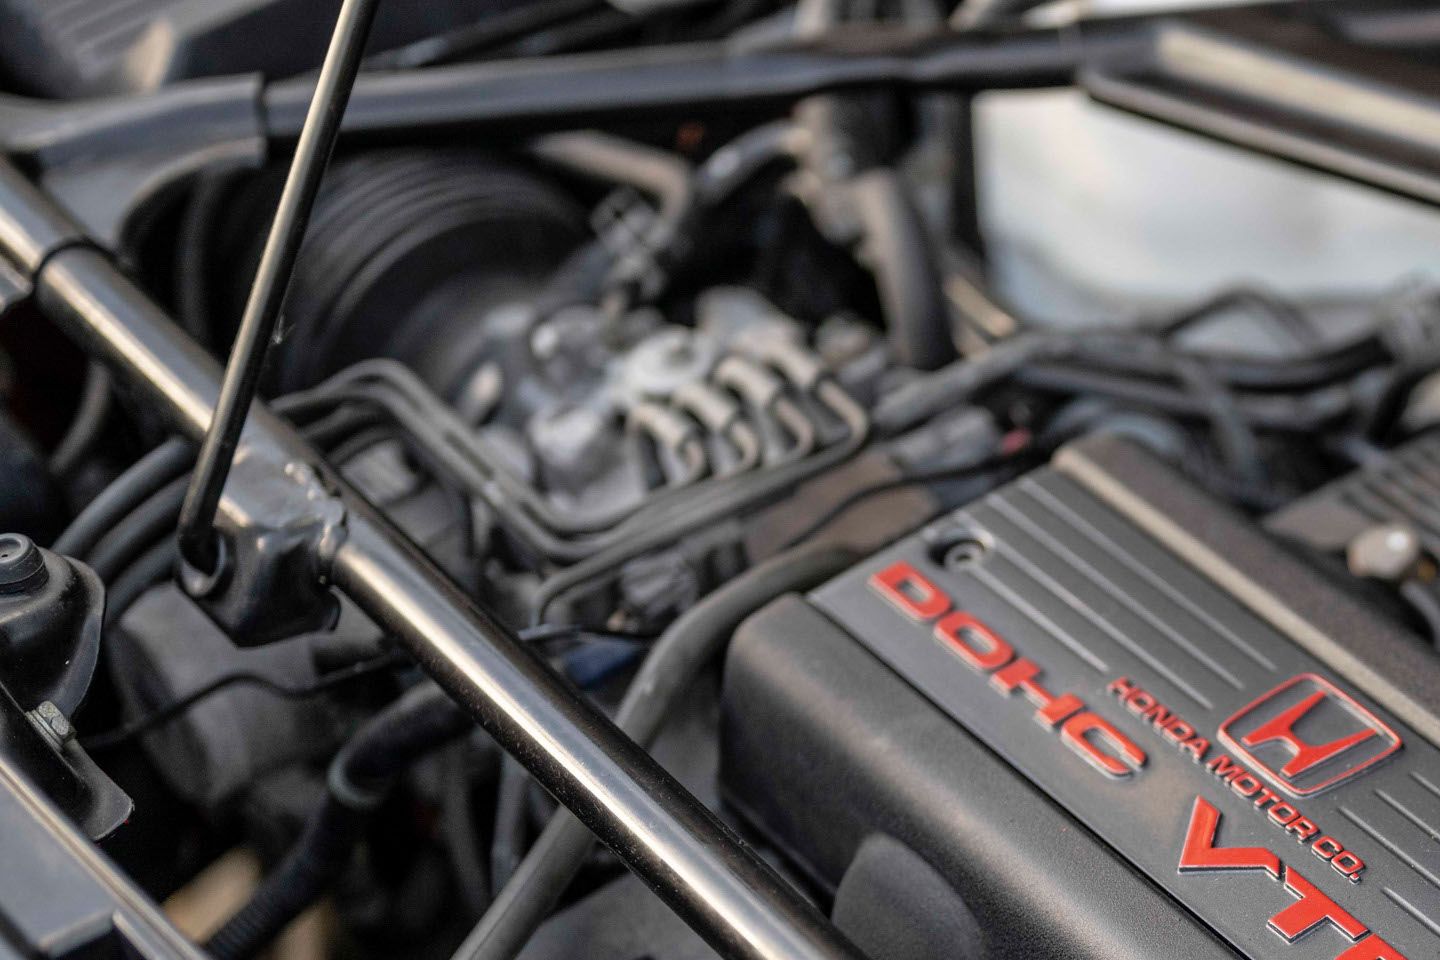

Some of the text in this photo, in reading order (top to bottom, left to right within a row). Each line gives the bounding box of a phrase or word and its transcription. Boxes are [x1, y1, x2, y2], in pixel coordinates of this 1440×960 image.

[870, 561, 1148, 779] DOHC
[1107, 676, 1366, 884] HONDA MOTOR CO.
